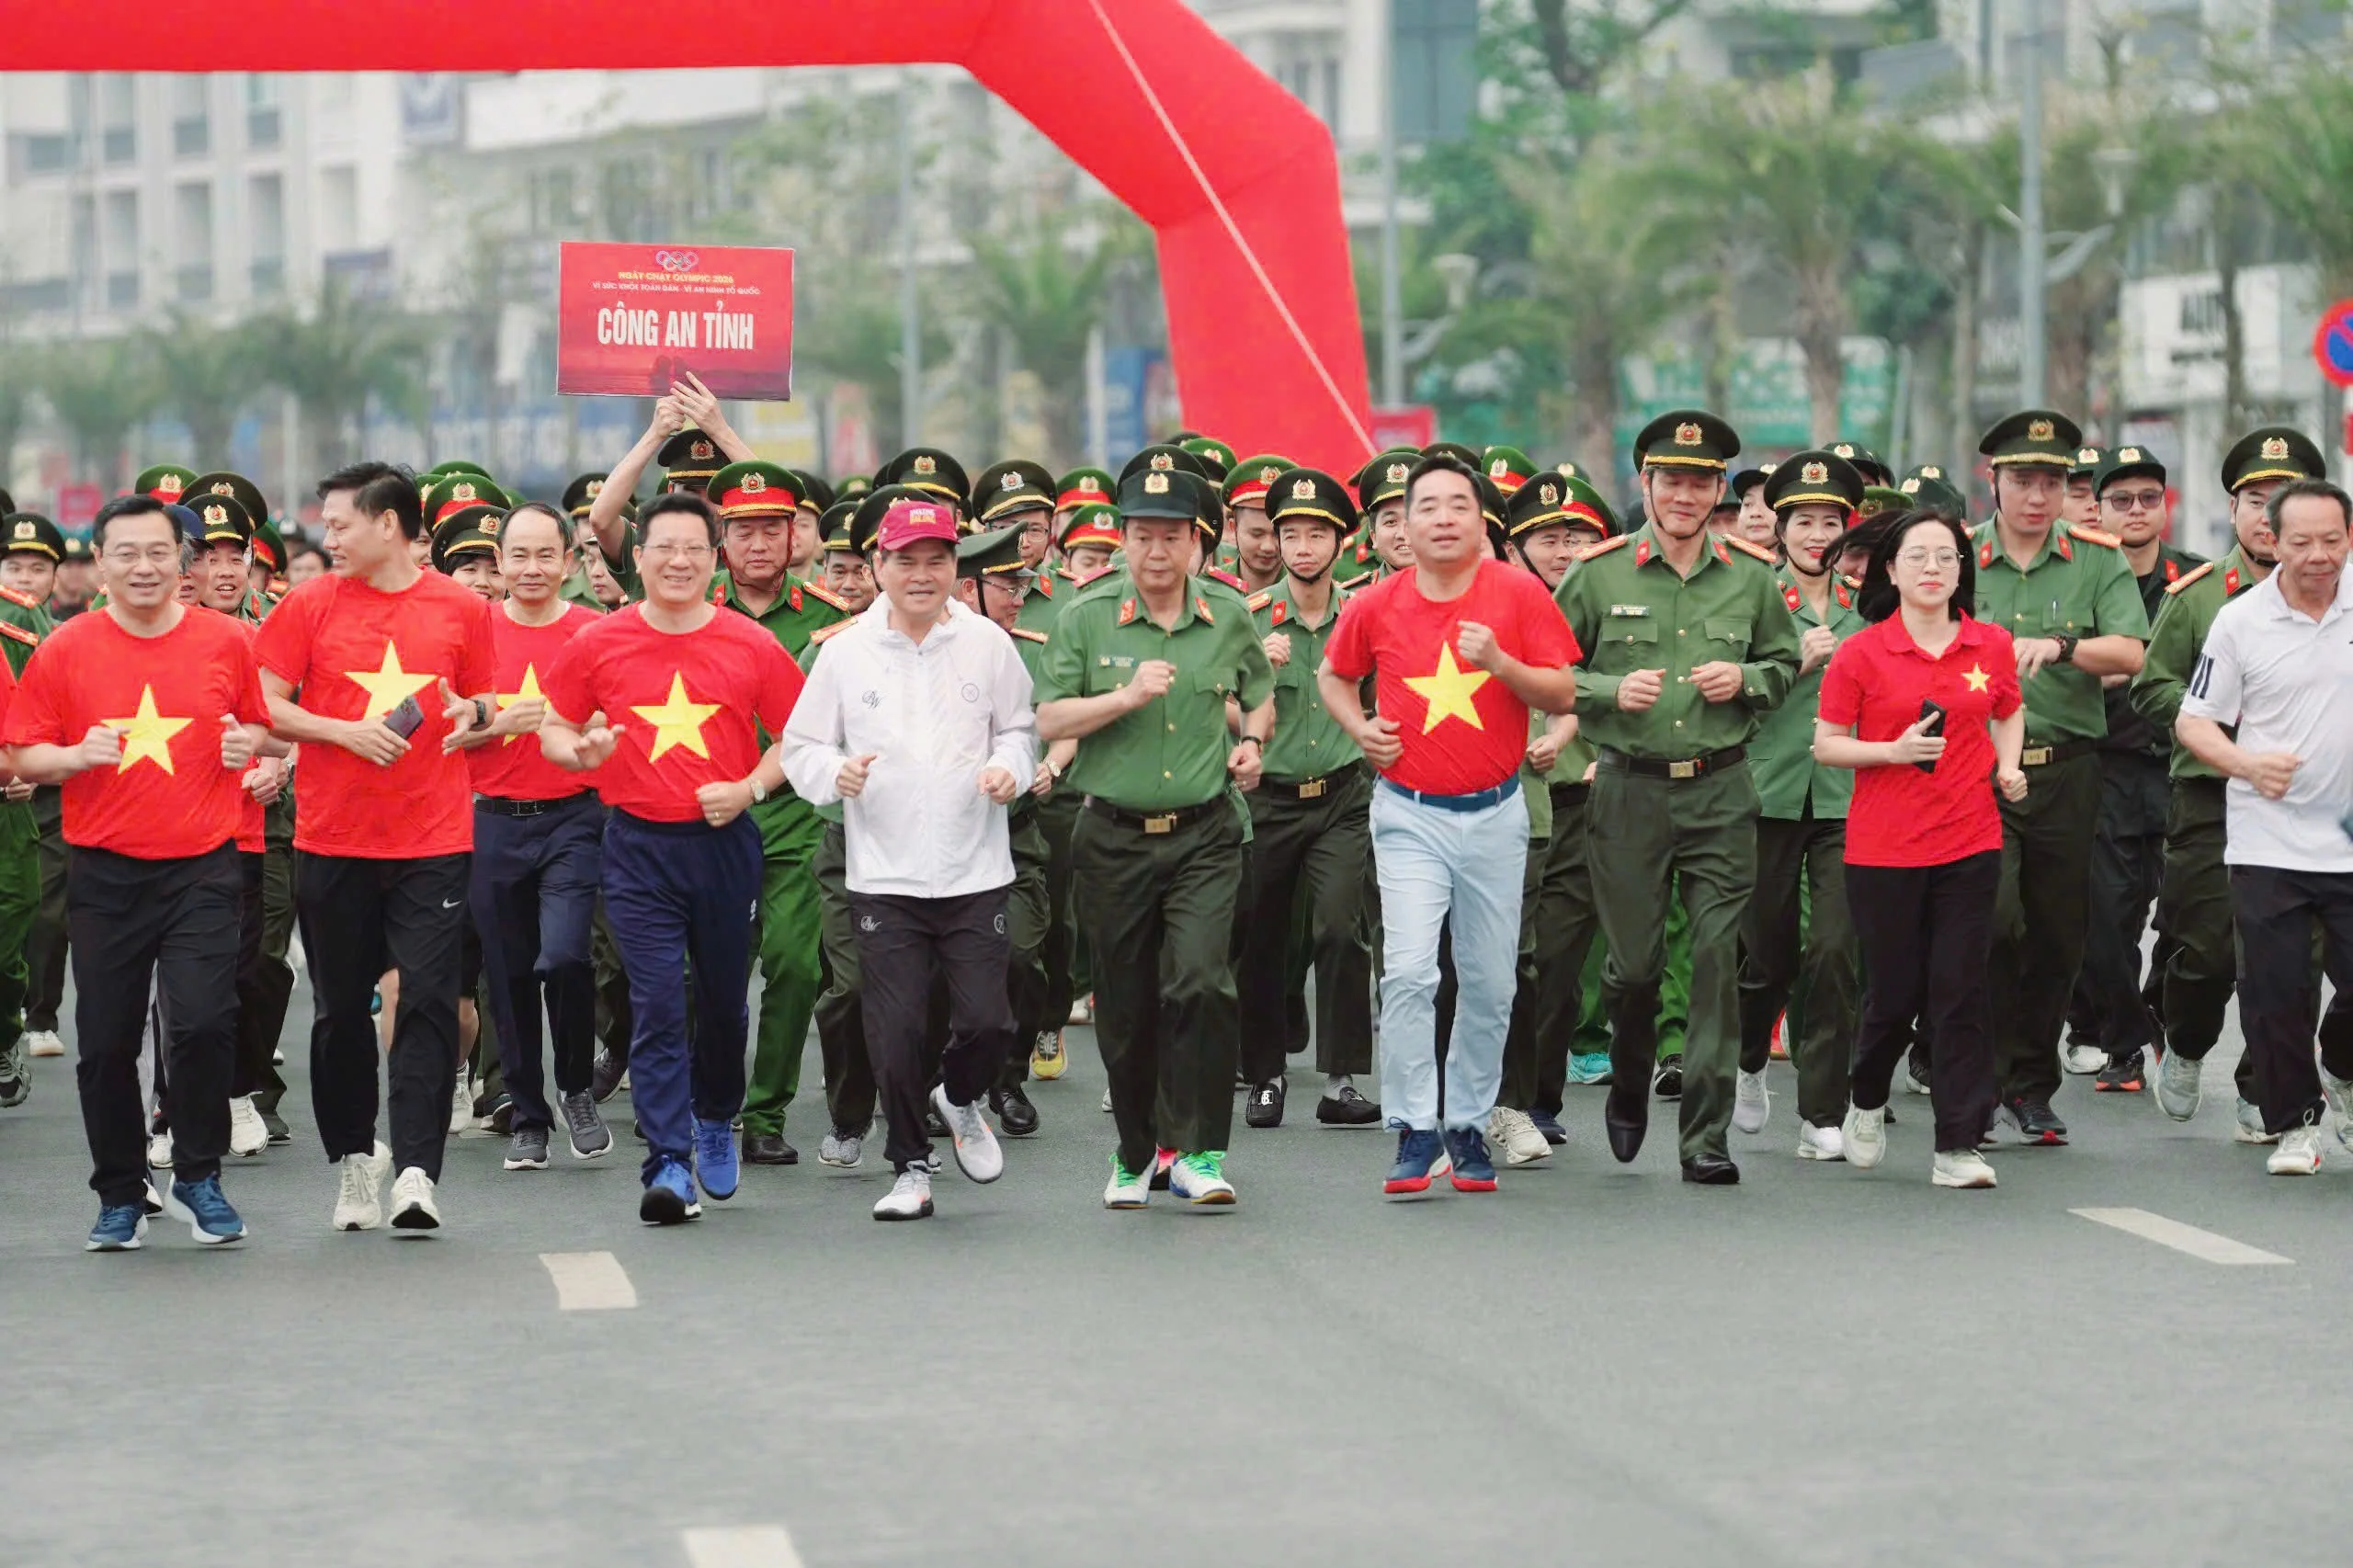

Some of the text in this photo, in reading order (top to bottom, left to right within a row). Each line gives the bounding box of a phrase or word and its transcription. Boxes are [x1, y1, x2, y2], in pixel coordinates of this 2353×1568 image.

[672, 273, 711, 283] OLYMPIC
[597, 300, 755, 349] CÔNG AN TỈNH
